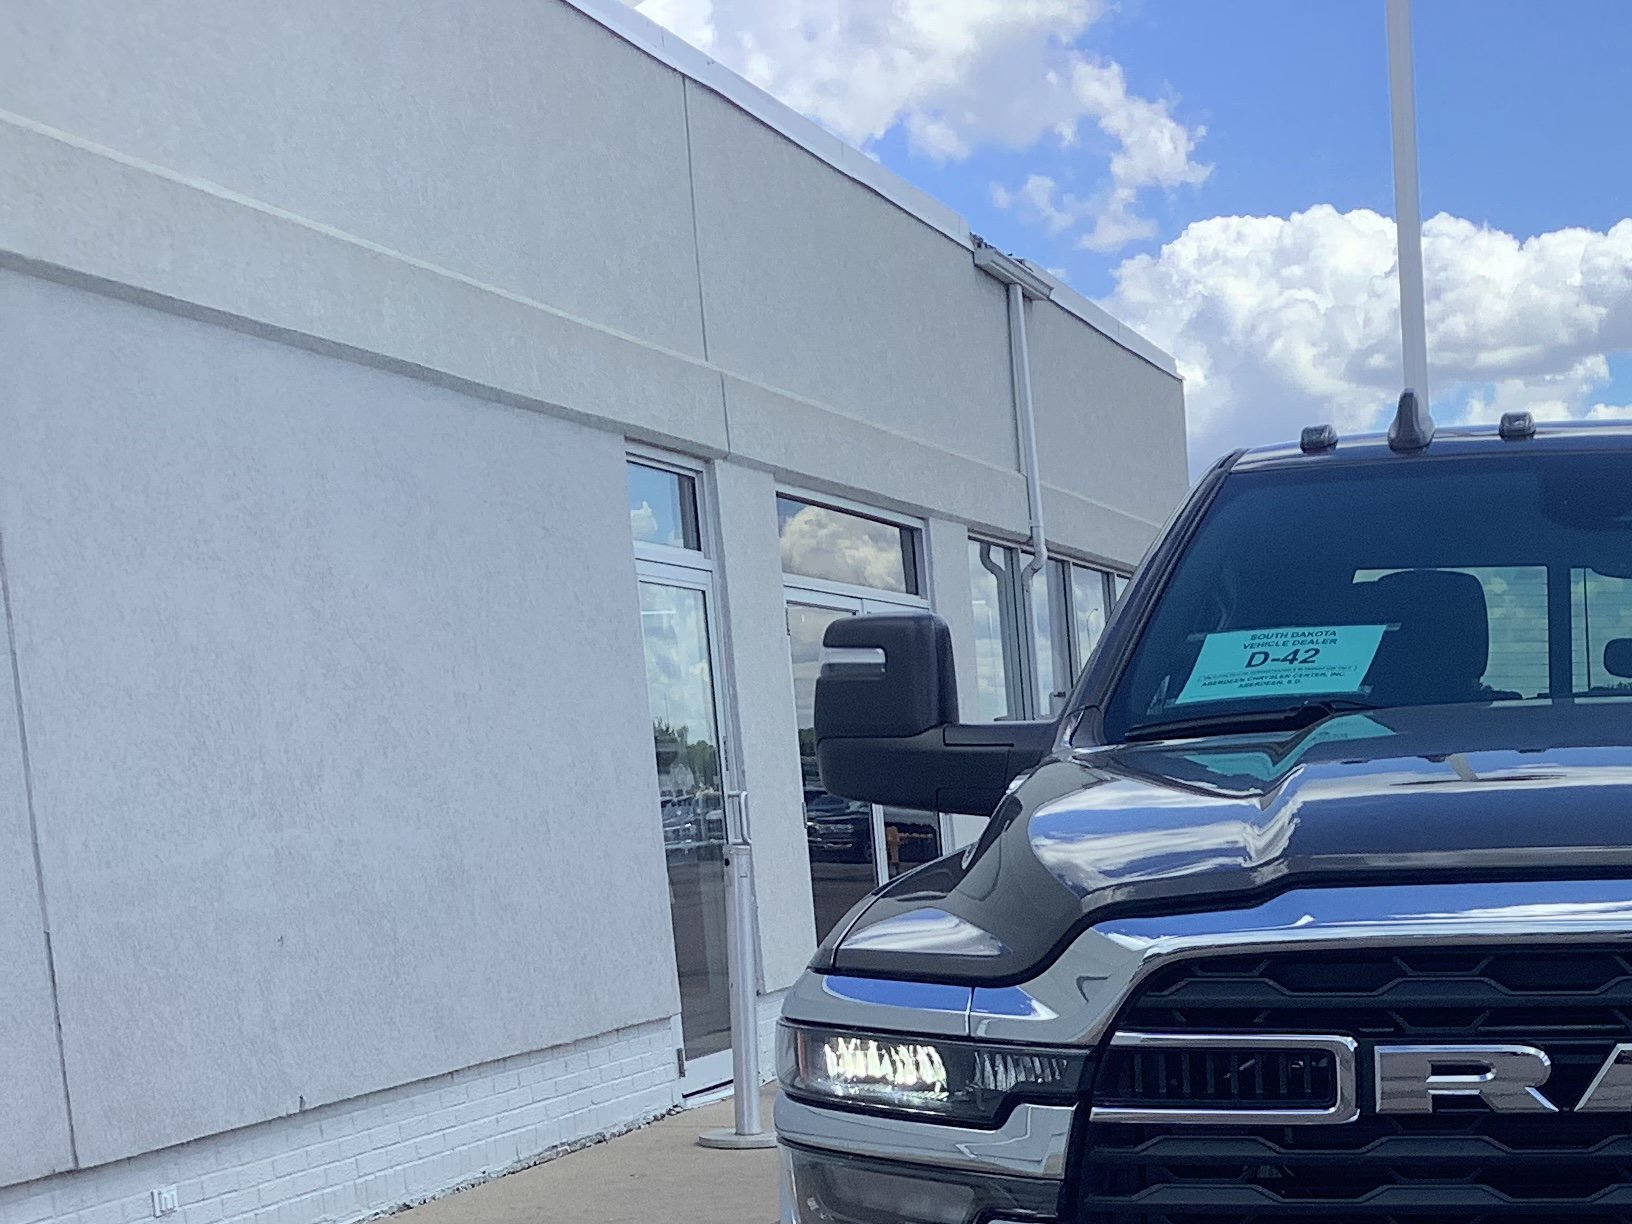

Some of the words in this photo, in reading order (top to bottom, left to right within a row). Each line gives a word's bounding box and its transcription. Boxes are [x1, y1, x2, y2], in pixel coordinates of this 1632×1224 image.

[1250, 631, 1288, 641] SOUTH
[1289, 630, 1337, 639] DAKOTA
[1243, 639, 1290, 650] VEHICLE
[1291, 638, 1338, 647] DEALER
[1244, 647, 1321, 668] D-42
